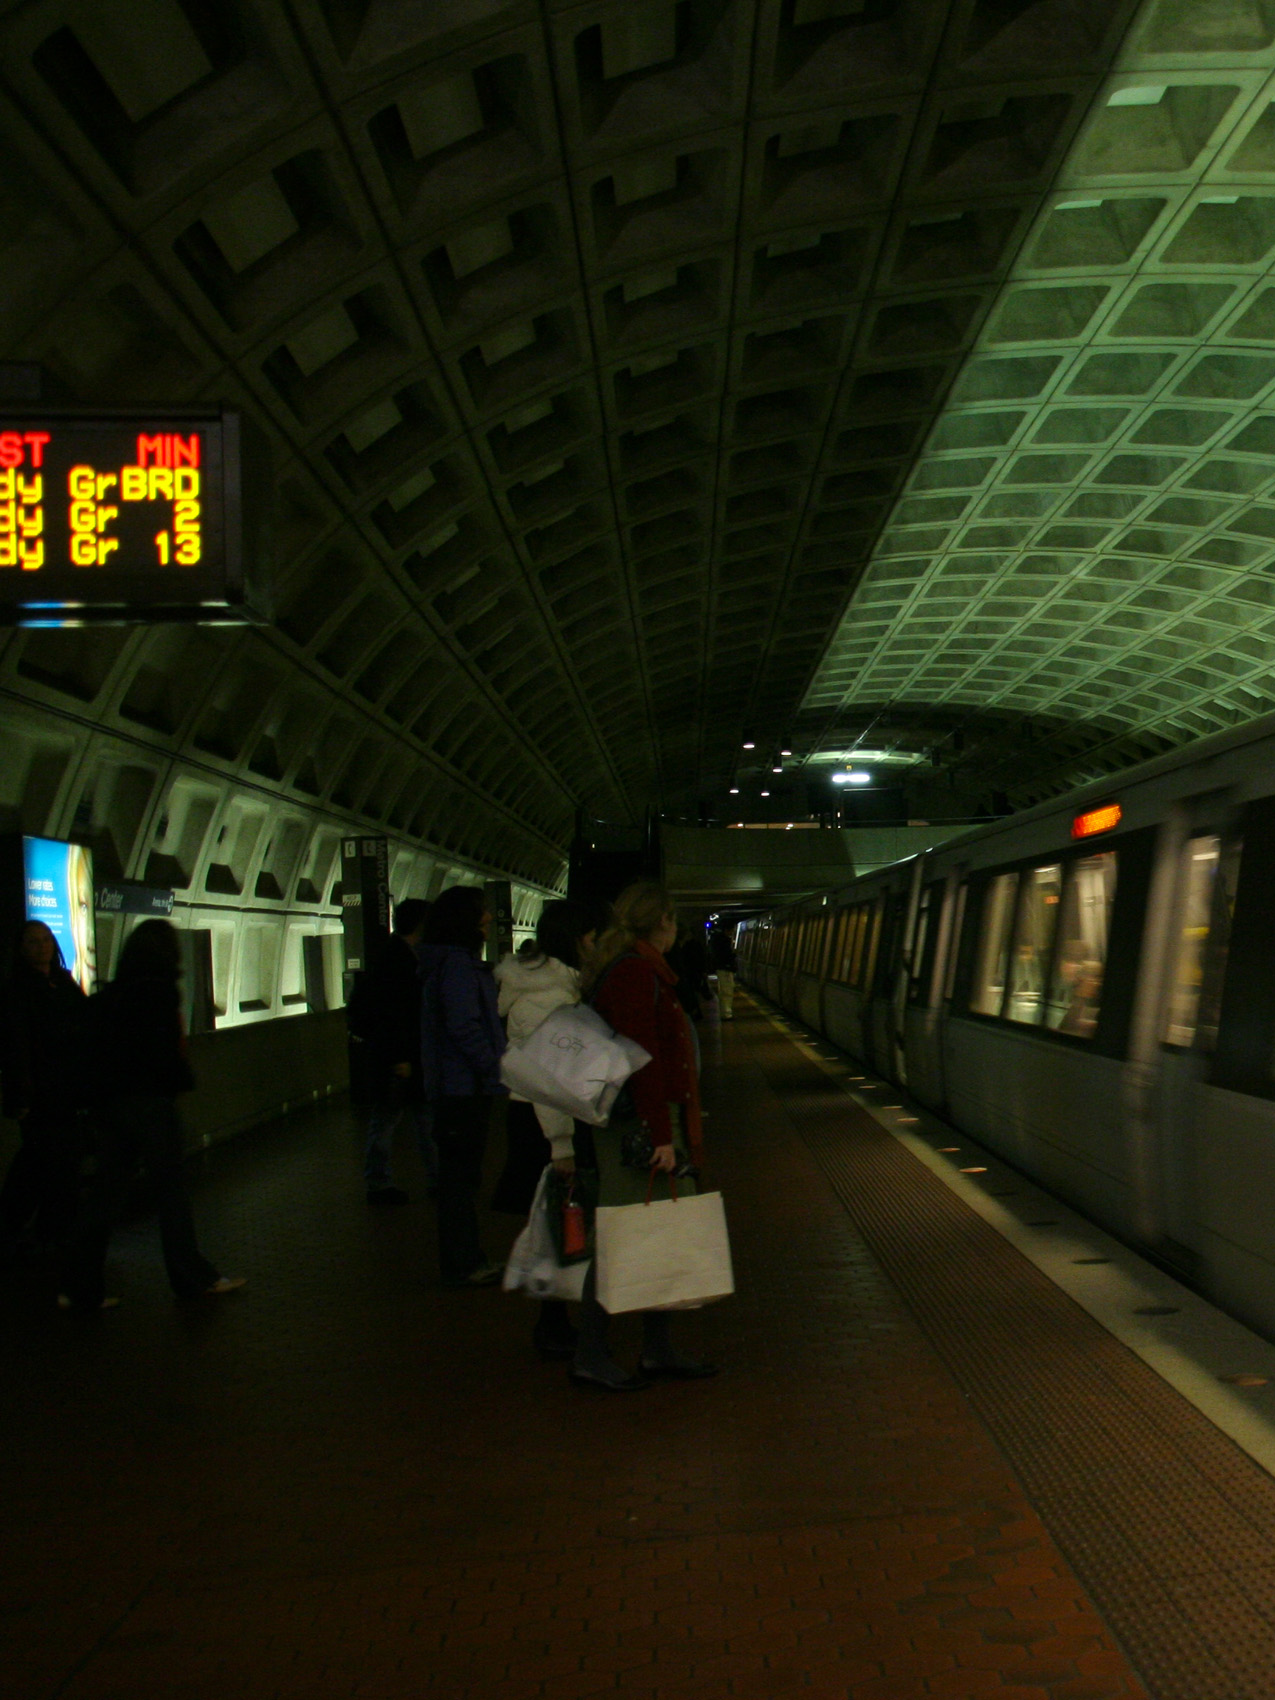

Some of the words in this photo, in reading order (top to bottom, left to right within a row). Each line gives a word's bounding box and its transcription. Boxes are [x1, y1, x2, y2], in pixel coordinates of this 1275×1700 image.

[137, 433, 200, 468] MIN
[69, 465, 118, 500] Gr
[120, 466, 200, 501] BRD
[69, 500, 118, 533] Gr
[173, 500, 201, 532] 2
[70, 532, 119, 566] Gr
[155, 530, 201, 566] 13
